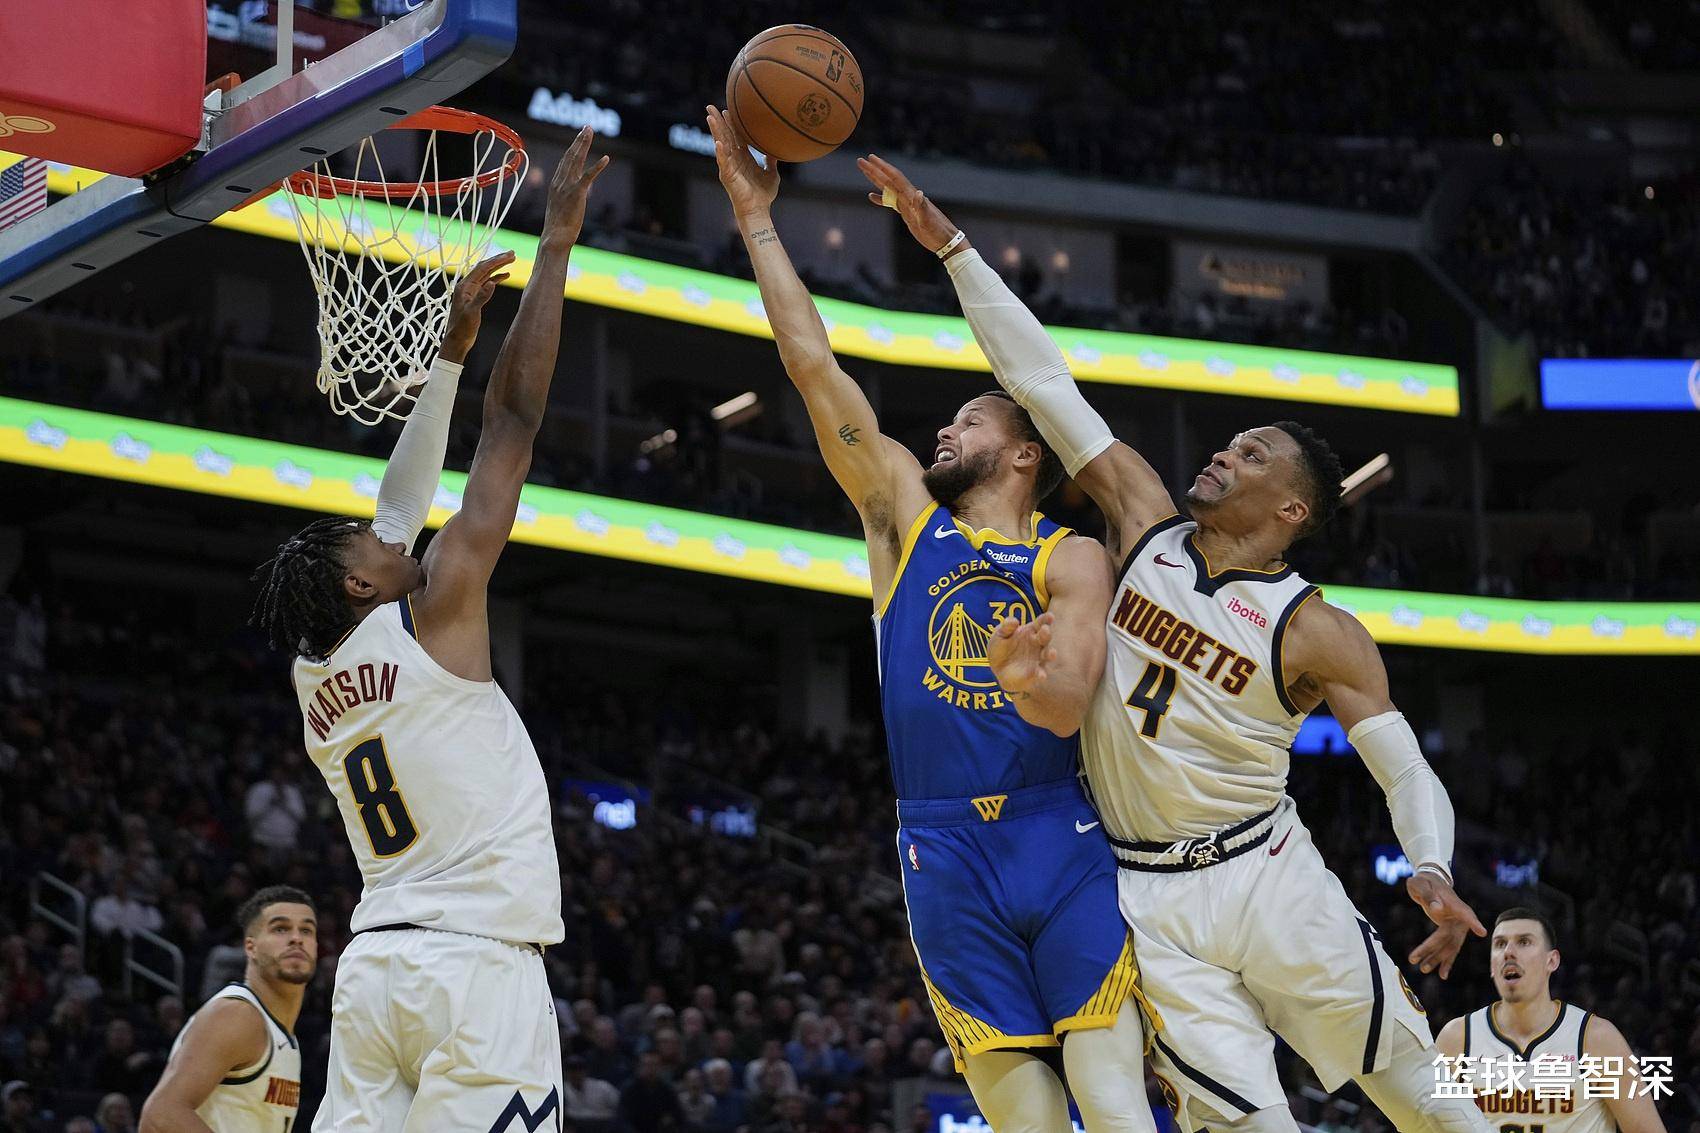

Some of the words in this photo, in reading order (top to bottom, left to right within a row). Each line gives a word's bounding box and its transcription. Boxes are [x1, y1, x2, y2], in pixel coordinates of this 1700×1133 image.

[928, 559, 991, 596] GOLDEN
[989, 601, 1027, 627] 30
[1111, 587, 1258, 697] NUGGETS
[1226, 597, 1268, 629] ibotta
[307, 662, 399, 743] WATSON
[922, 666, 1013, 710] WARRI
[1125, 661, 1177, 740] 4
[342, 733, 420, 859] 8
